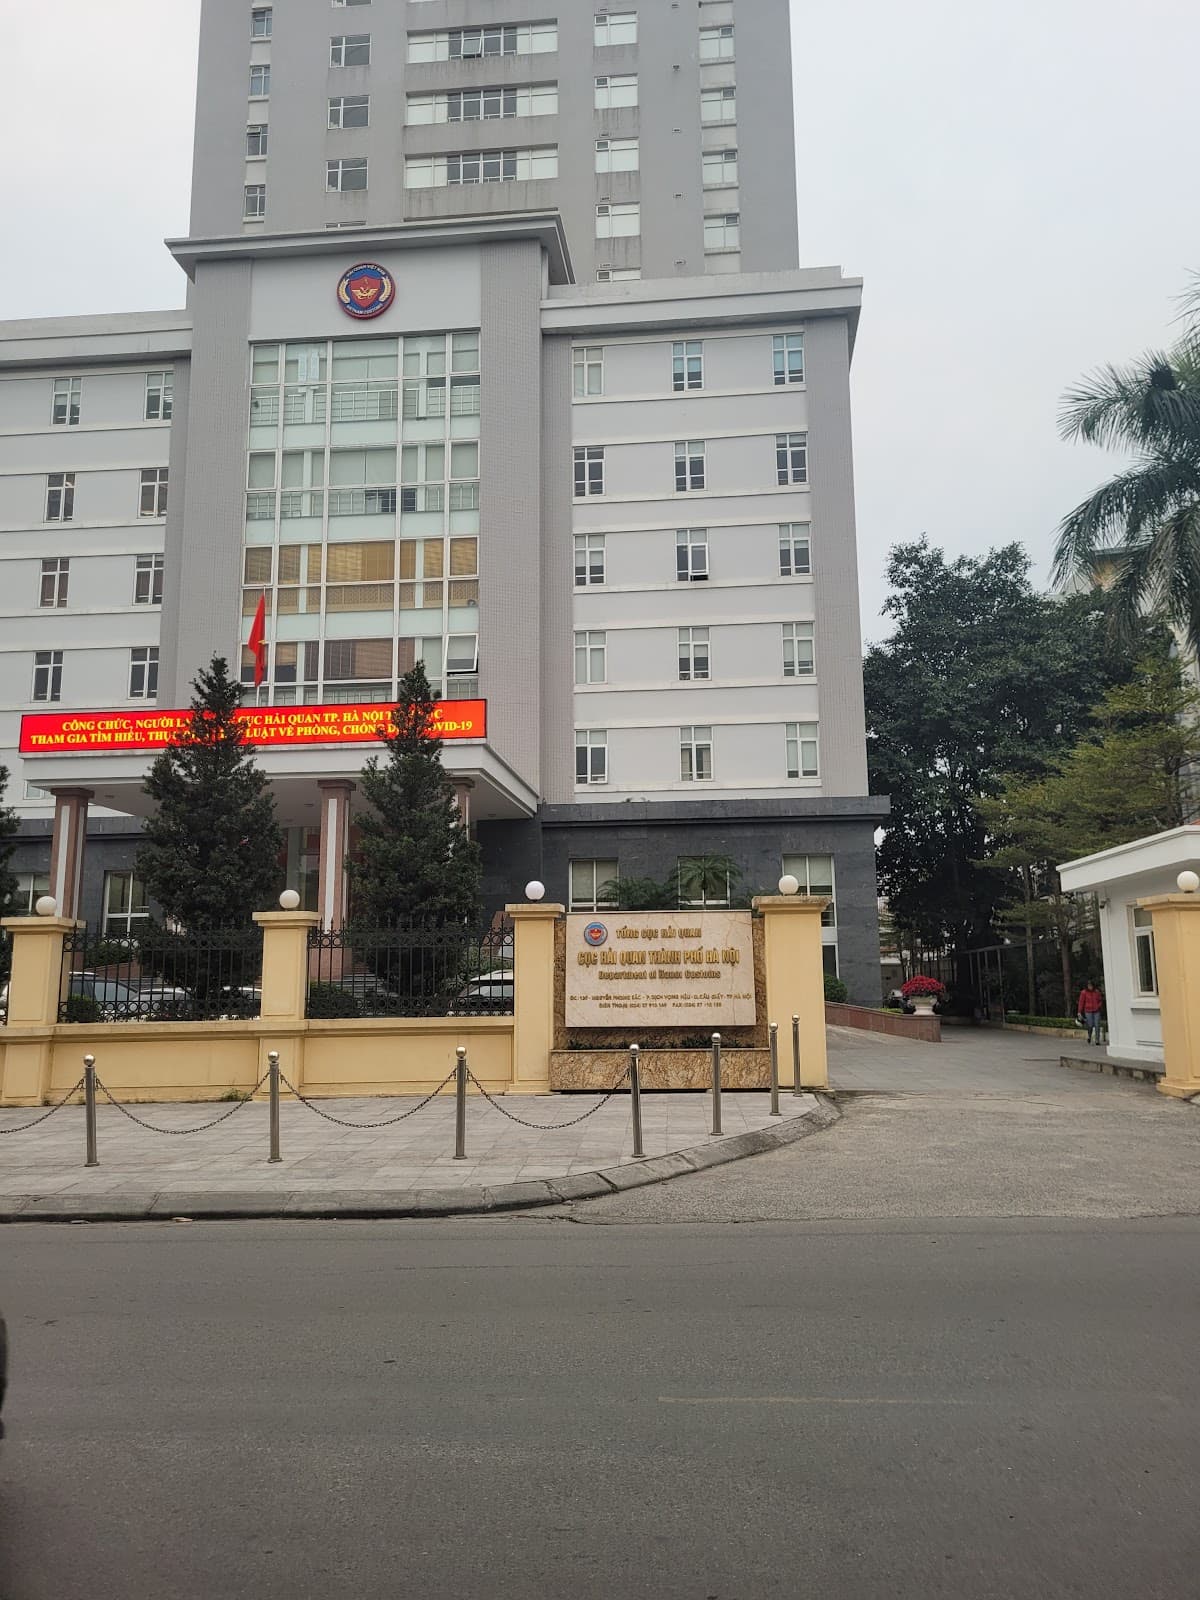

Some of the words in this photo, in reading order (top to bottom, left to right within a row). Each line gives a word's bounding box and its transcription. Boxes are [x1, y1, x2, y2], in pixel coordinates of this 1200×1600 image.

[62, 719, 95, 731] CÔNG
[97, 718, 133, 732] CHỨC,
[135, 716, 174, 729] NGƯỜI
[264, 712, 285, 724] HẢI
[287, 713, 320, 725] QUAN
[323, 712, 340, 723] TP.
[343, 709, 359, 721] HÀ
[362, 710, 384, 723] NỘI
[31, 734, 65, 744] THAM
[67, 733, 88, 743] GIA
[90, 730, 112, 742] TÌM
[115, 728, 145, 742] HIỂU,
[246, 727, 277, 739] LUẬT
[279, 725, 294, 736] VỀ
[297, 724, 340, 737] PHÒNG,
[616, 925, 639, 938] TỔNG
[641, 928, 659, 941] CỤC
[661, 925, 676, 938] HẢI
[678, 928, 702, 939] QUAN
[577, 951, 598, 968] CỤC
[600, 947, 617, 965] HẢI
[620, 950, 646, 966] QUAN
[648, 947, 681, 964] THÀNH
[683, 945, 703, 964] PHỐ
[705, 947, 720, 964] HÀ
[721, 947, 740, 967] NỘI
